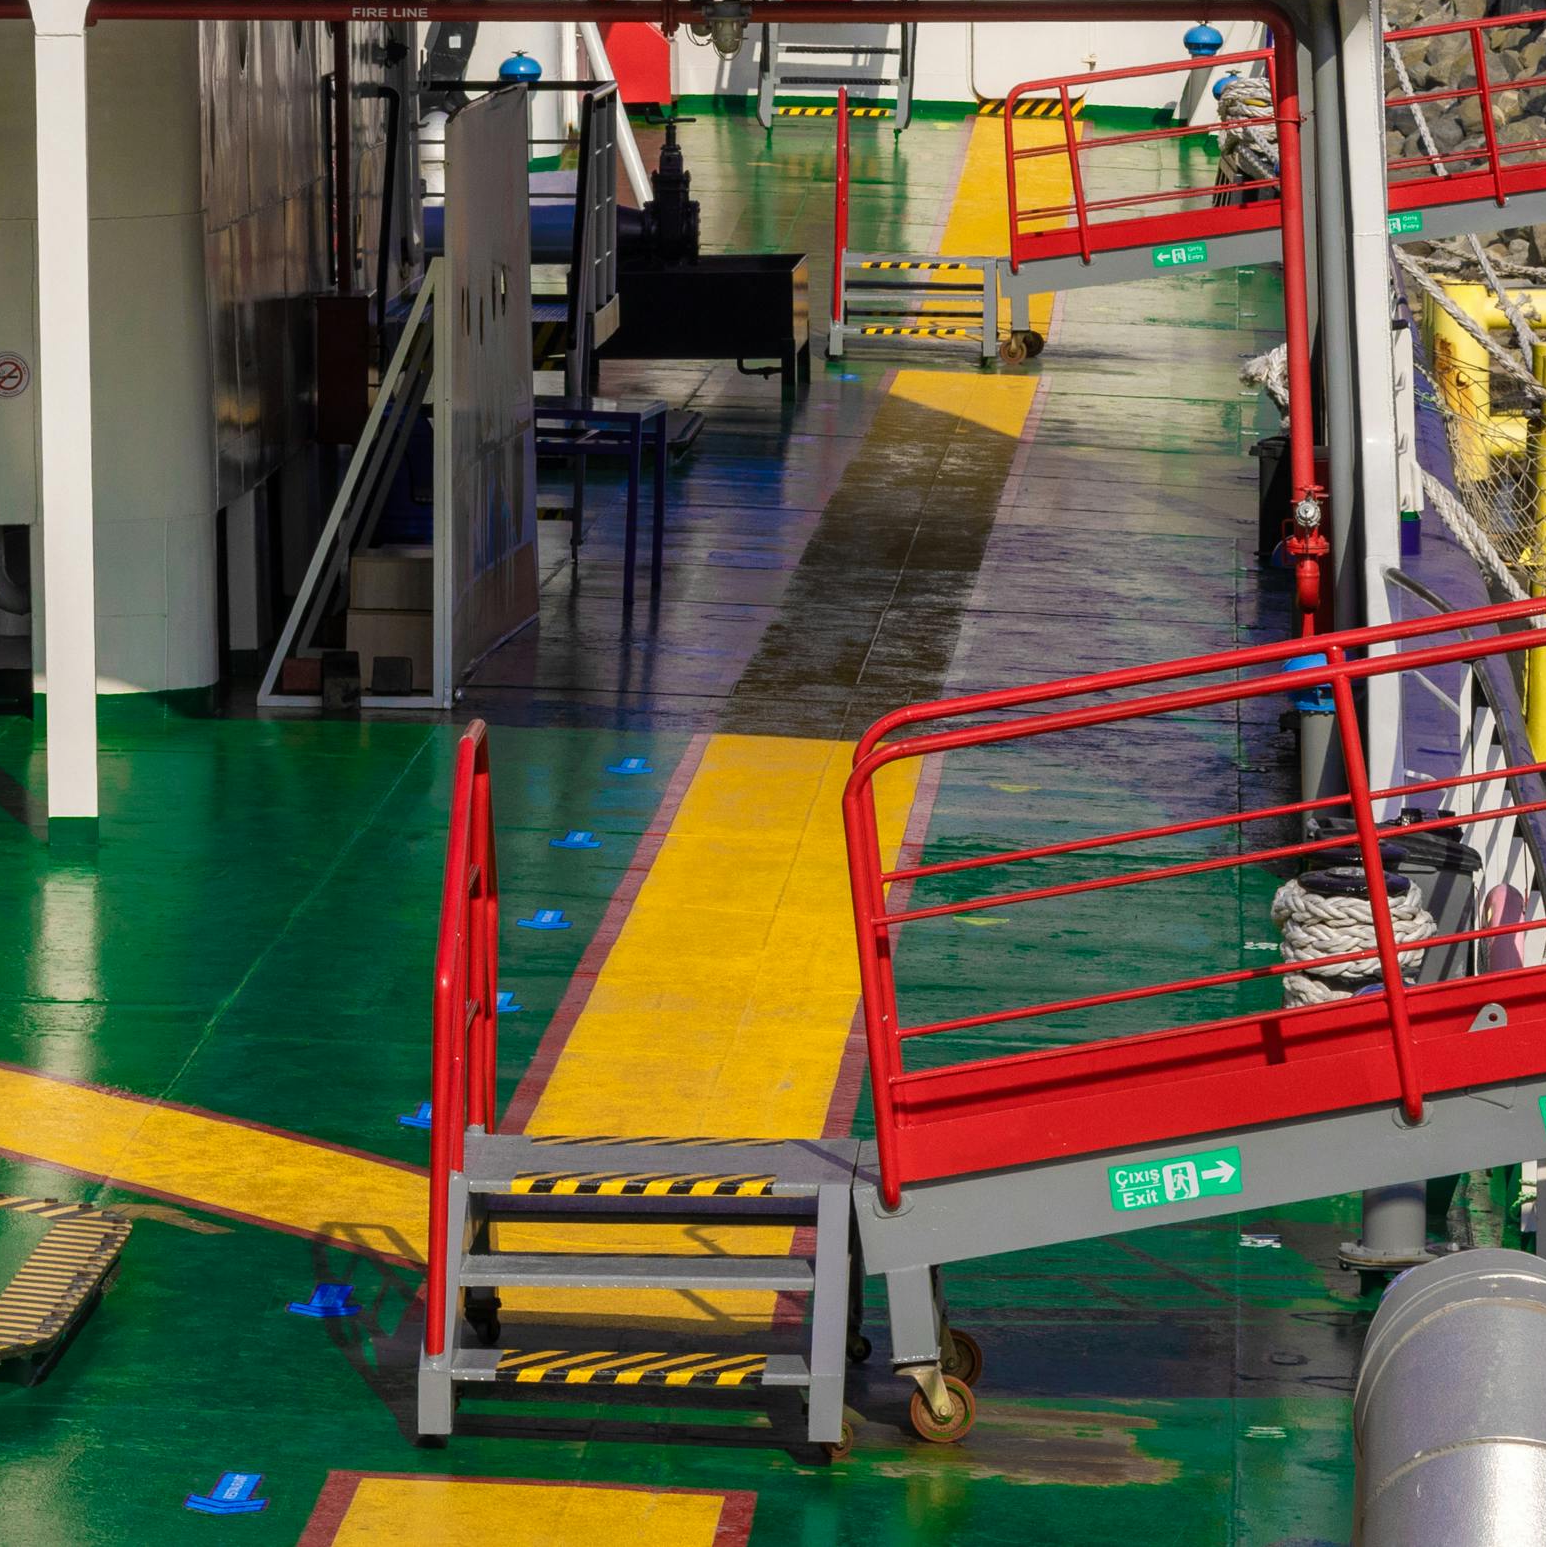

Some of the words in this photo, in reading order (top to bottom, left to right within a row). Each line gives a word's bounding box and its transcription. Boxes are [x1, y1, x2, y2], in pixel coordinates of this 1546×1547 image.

[352, 7, 388, 18] FIRE
[393, 7, 428, 18] LINE
[1122, 1189, 1159, 1208] Exit
